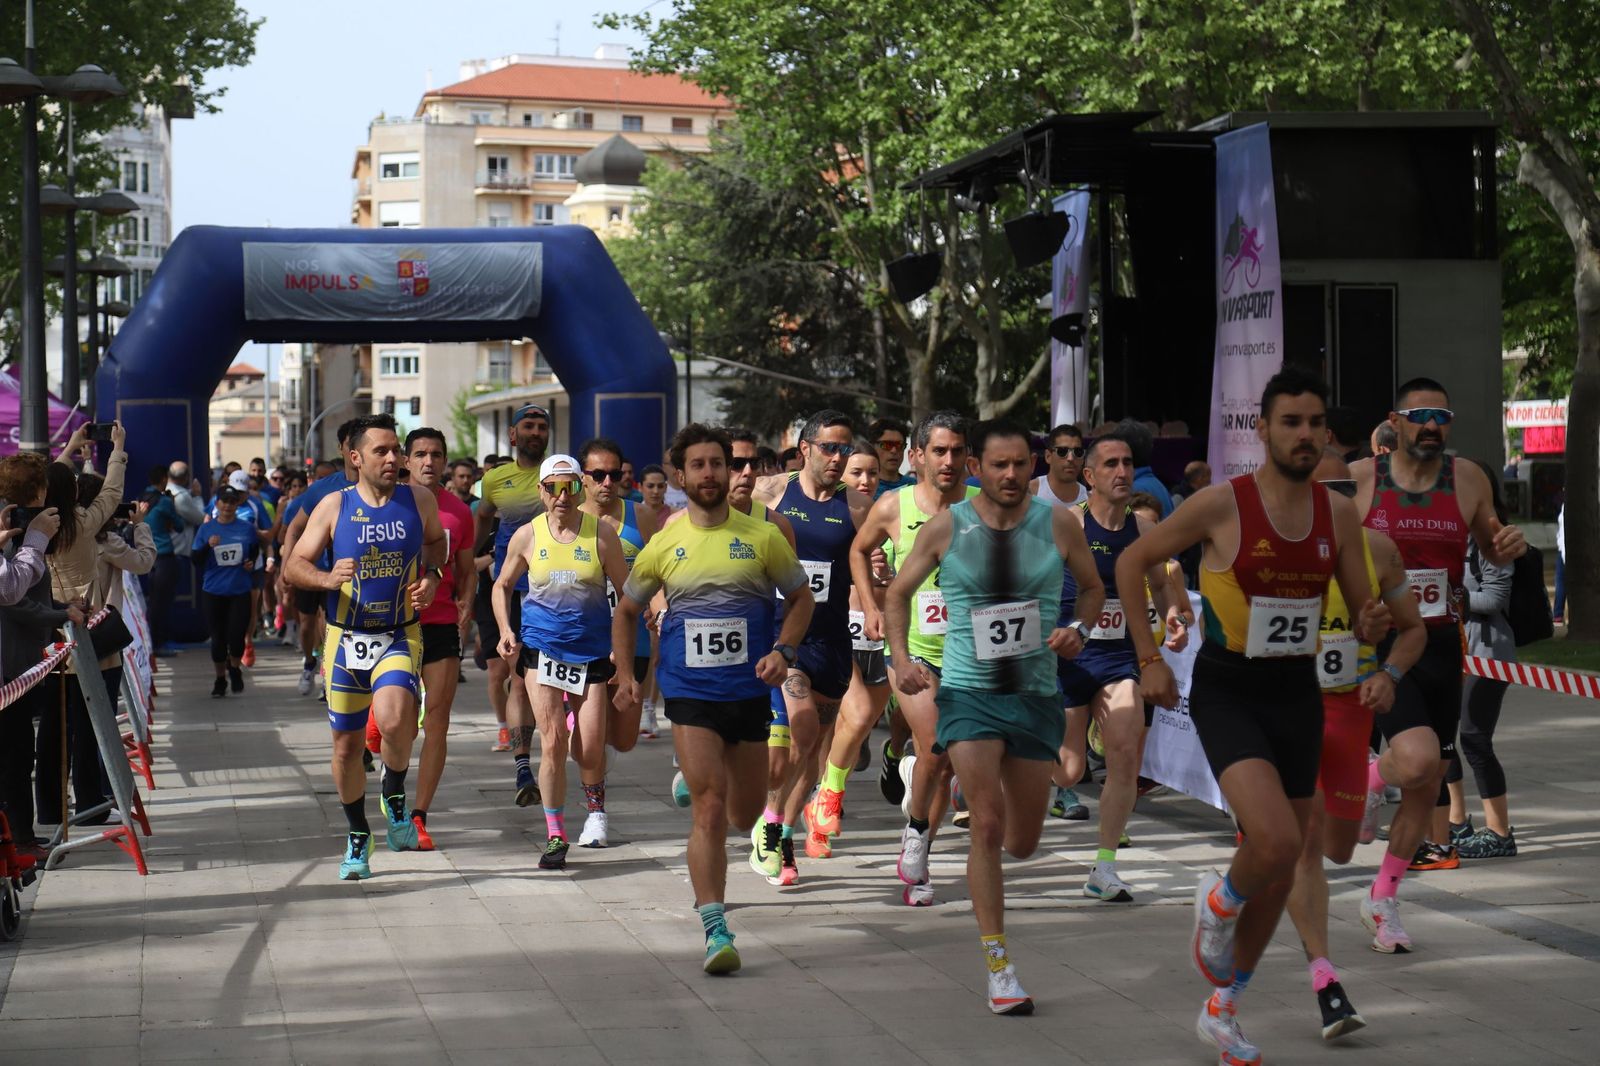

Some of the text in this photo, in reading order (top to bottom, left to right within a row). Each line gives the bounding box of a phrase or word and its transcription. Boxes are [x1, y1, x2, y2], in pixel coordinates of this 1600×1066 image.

[284, 259, 320, 272] NOS
[1516, 407, 1533, 421] POR
[1396, 518, 1424, 529] APIS
[357, 520, 406, 544] JESUS
[221, 550, 237, 561] 87
[729, 552, 756, 560] DUERO
[360, 557, 403, 569] TRIATLON
[360, 566, 403, 580] DUERO
[550, 570, 577, 584] PRIETO
[993, 607, 1017, 615] CASTILLA
[989, 617, 1026, 645] 37
[1267, 616, 1309, 643] 25
[692, 631, 743, 655] 156
[544, 661, 581, 685] 185
